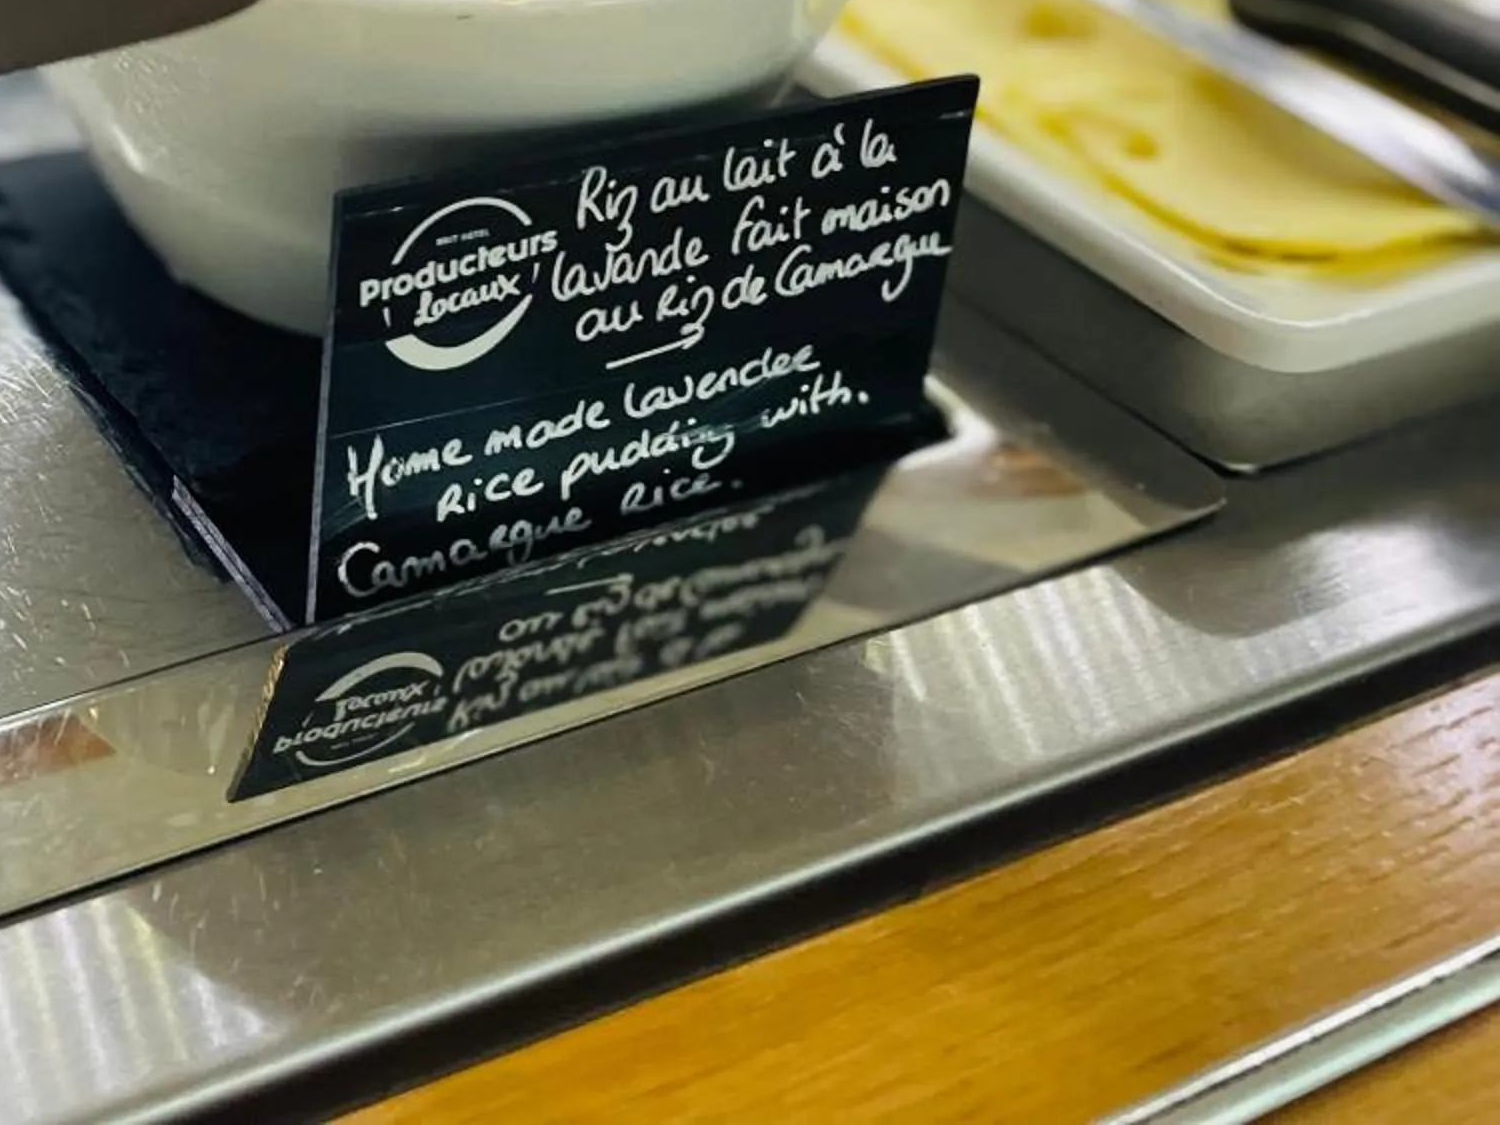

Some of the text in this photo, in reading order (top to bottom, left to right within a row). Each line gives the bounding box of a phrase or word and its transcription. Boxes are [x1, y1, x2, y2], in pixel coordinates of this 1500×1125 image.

[577, 166, 638, 251] Riz
[650, 175, 710, 213] au
[723, 138, 797, 191] lait
[859, 118, 897, 168] la
[821, 178, 951, 235] maison
[360, 230, 558, 308] Producteurs
[413, 272, 521, 327] Locaux
[575, 301, 643, 342] au
[721, 264, 768, 310] de
[348, 433, 473, 520] Home
[485, 399, 611, 458] made
